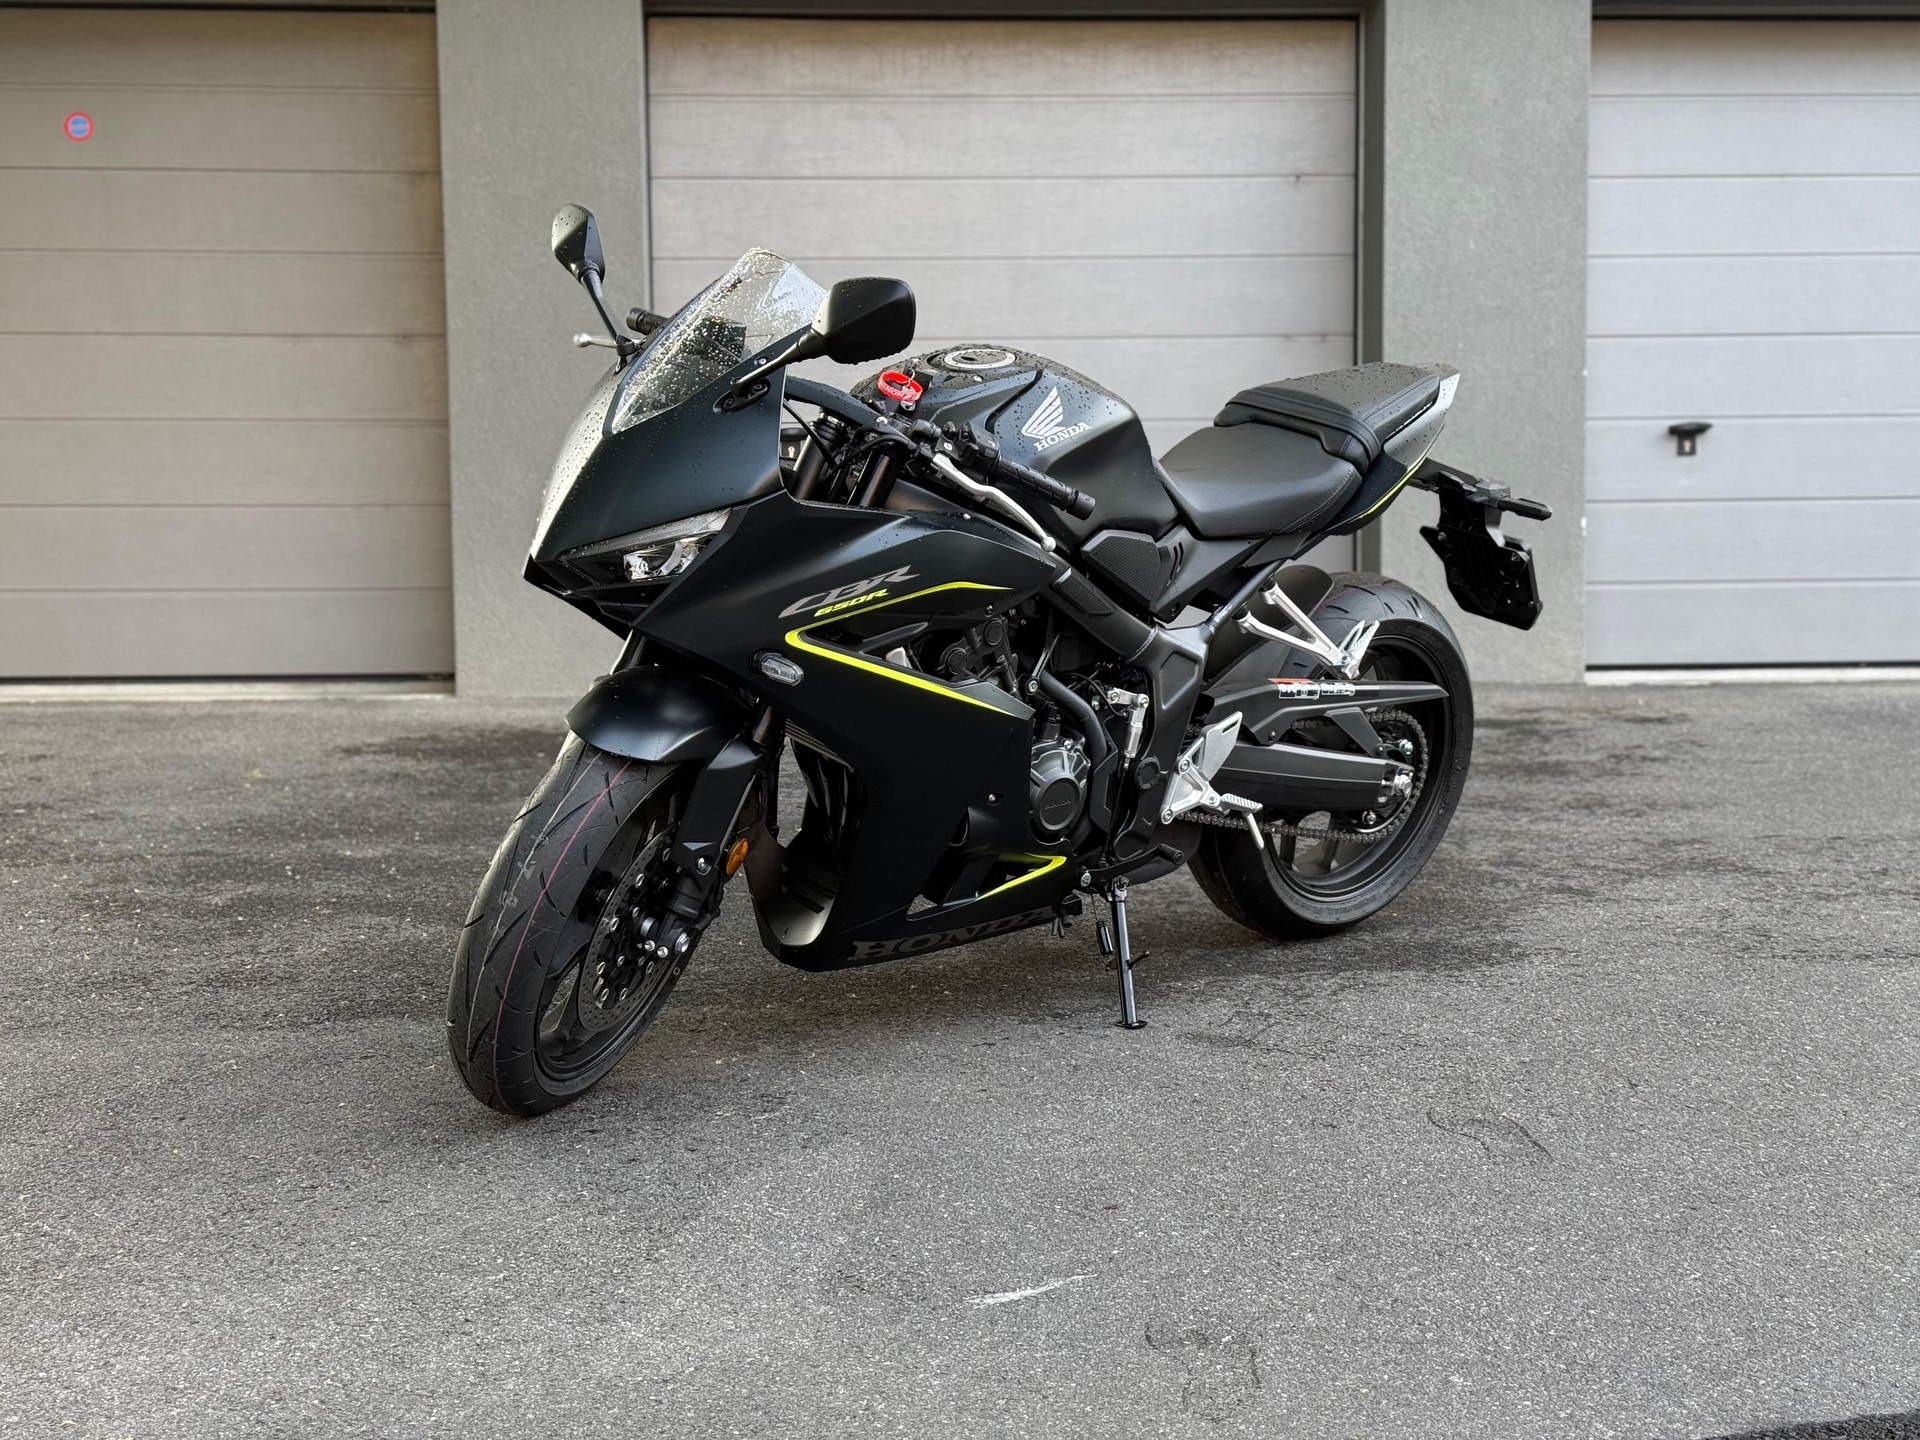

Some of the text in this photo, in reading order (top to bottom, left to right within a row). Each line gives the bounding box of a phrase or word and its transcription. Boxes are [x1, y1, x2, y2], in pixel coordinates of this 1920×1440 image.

[1033, 421, 1092, 452] HONDA
[778, 564, 921, 619] CBR
[813, 588, 890, 617] 650R
[847, 905, 1056, 961] HONDA
